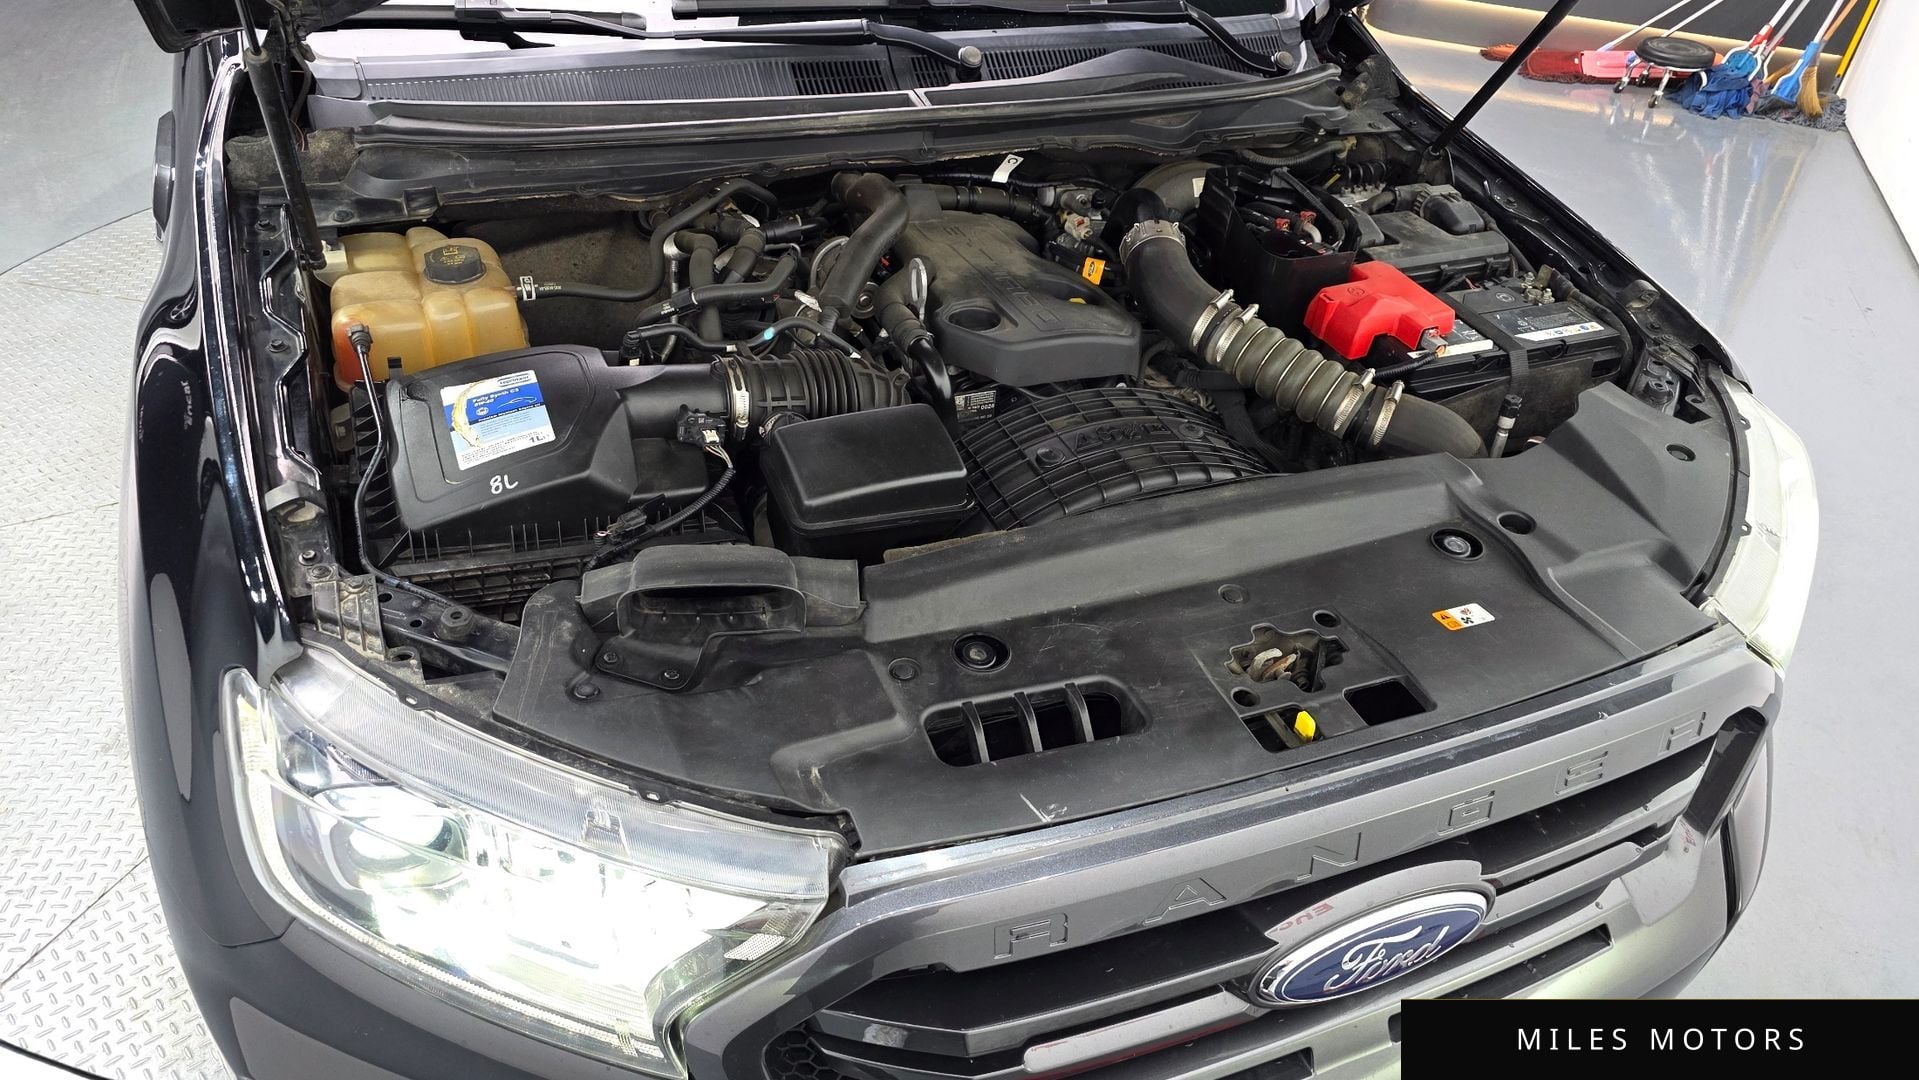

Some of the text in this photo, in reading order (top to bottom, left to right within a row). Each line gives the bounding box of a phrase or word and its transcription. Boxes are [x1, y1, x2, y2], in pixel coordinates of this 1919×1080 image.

[490, 474, 519, 495] 8L
[993, 711, 1706, 961] RANGER
[1324, 925, 1447, 993] Ford
